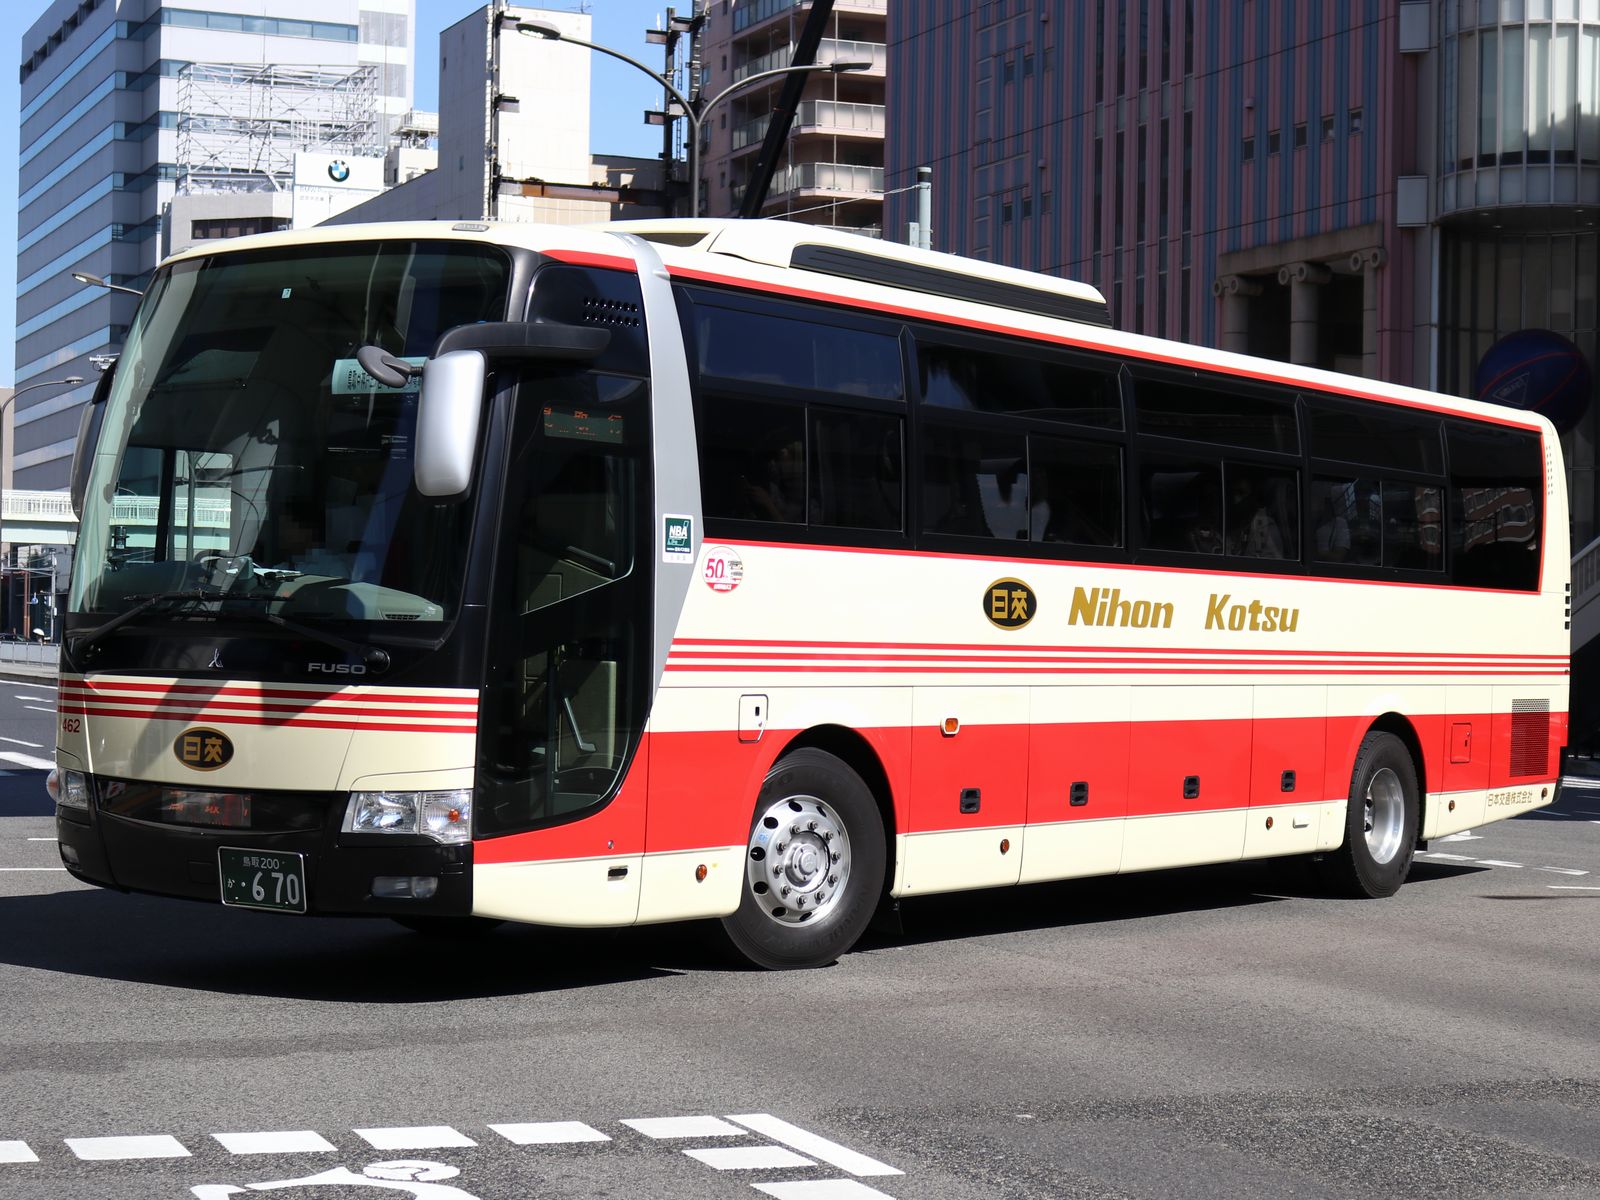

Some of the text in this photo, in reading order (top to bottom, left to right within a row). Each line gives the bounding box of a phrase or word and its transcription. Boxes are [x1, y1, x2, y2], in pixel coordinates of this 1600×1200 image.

[669, 525, 688, 537] NBA
[705, 558, 725, 578] 50
[992, 589, 1028, 619] 日交
[1067, 586, 1300, 633] Nihon Kotsu
[307, 662, 367, 675] FUSO
[63, 718, 81, 733] 462
[183, 736, 224, 763] 日交
